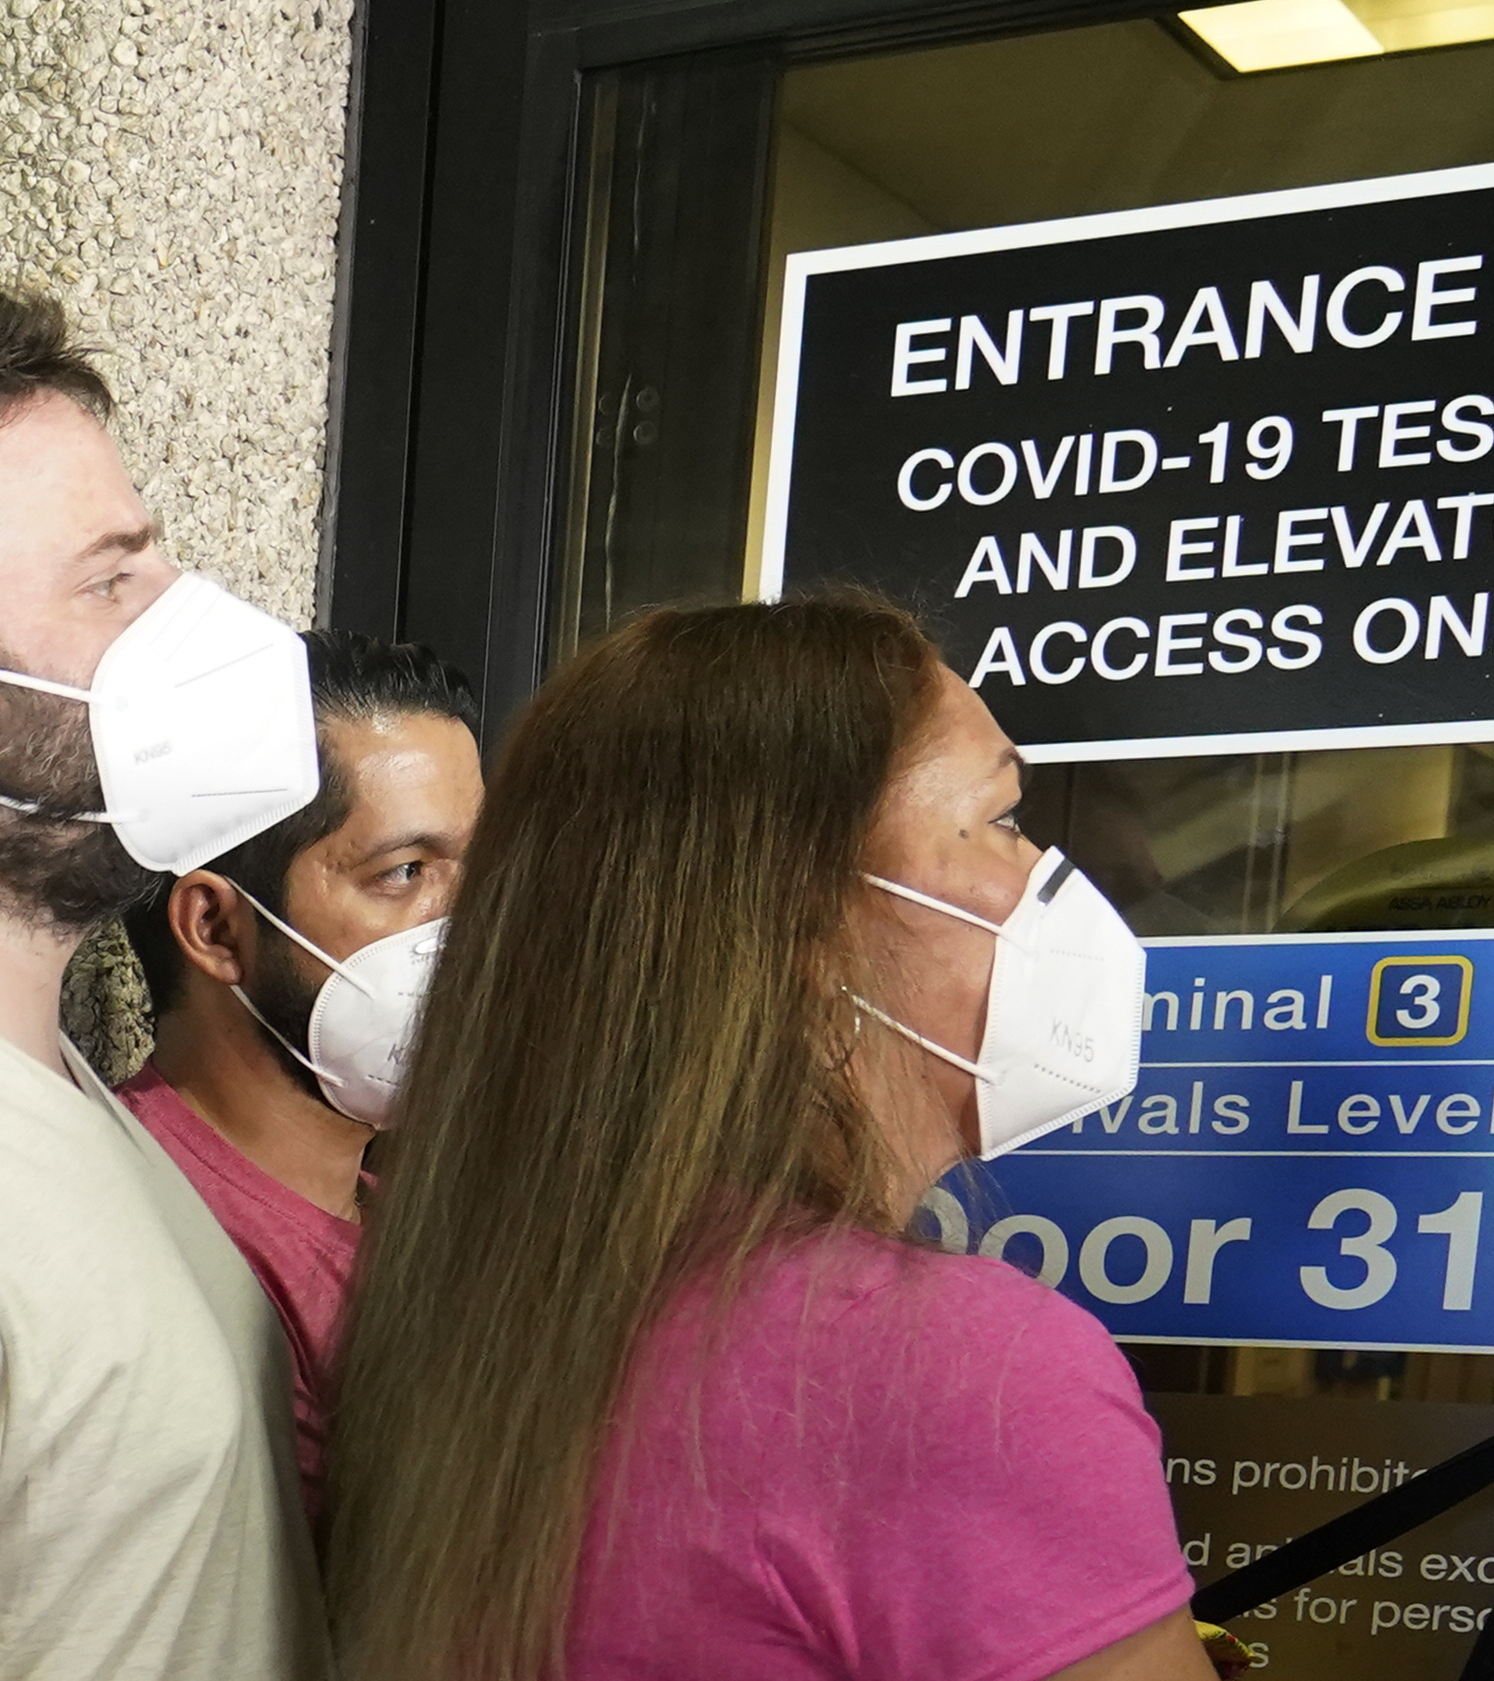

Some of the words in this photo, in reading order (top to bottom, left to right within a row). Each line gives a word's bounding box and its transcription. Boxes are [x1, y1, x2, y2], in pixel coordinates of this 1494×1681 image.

[891, 255, 1483, 398] ENTRANCE
[897, 414, 1295, 512] COVID-19
[954, 525, 1137, 599] AND
[968, 604, 1324, 688] ACCESS
[1352, 591, 1490, 664] ON
[1141, 975, 1333, 1031] minal
[1395, 974, 1442, 1029] 3
[1050, 1016, 1095, 1063] KN95
[1286, 1080, 1494, 1136] Leve
[1299, 1188, 1484, 1311] 31
[1166, 1457, 1217, 1486] ns
[1232, 1455, 1428, 1495] prohibit
[1293, 1587, 1358, 1624] for
